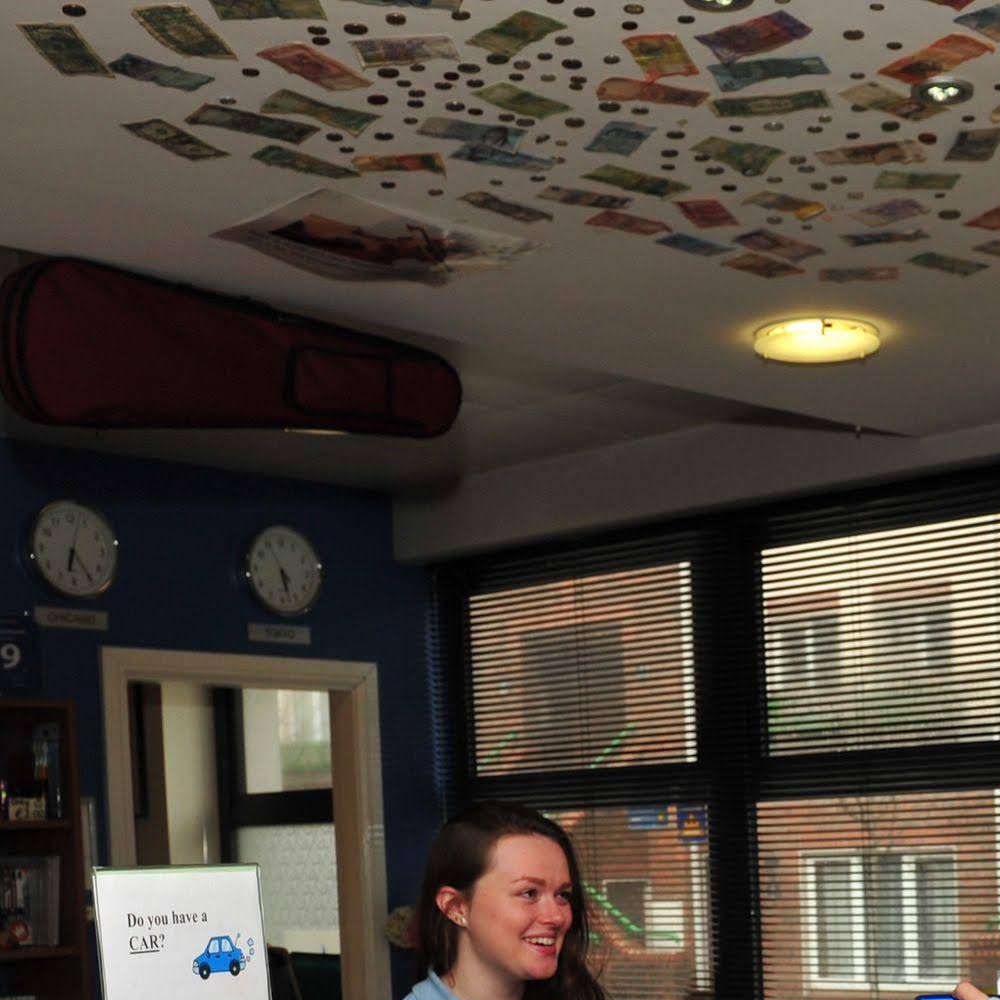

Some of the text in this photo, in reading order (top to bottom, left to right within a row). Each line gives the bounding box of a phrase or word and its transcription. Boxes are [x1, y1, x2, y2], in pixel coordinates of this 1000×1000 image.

[0, 643, 21, 669] 9
[127, 911, 208, 930] Do you have a
[129, 934, 166, 951] CAR?
